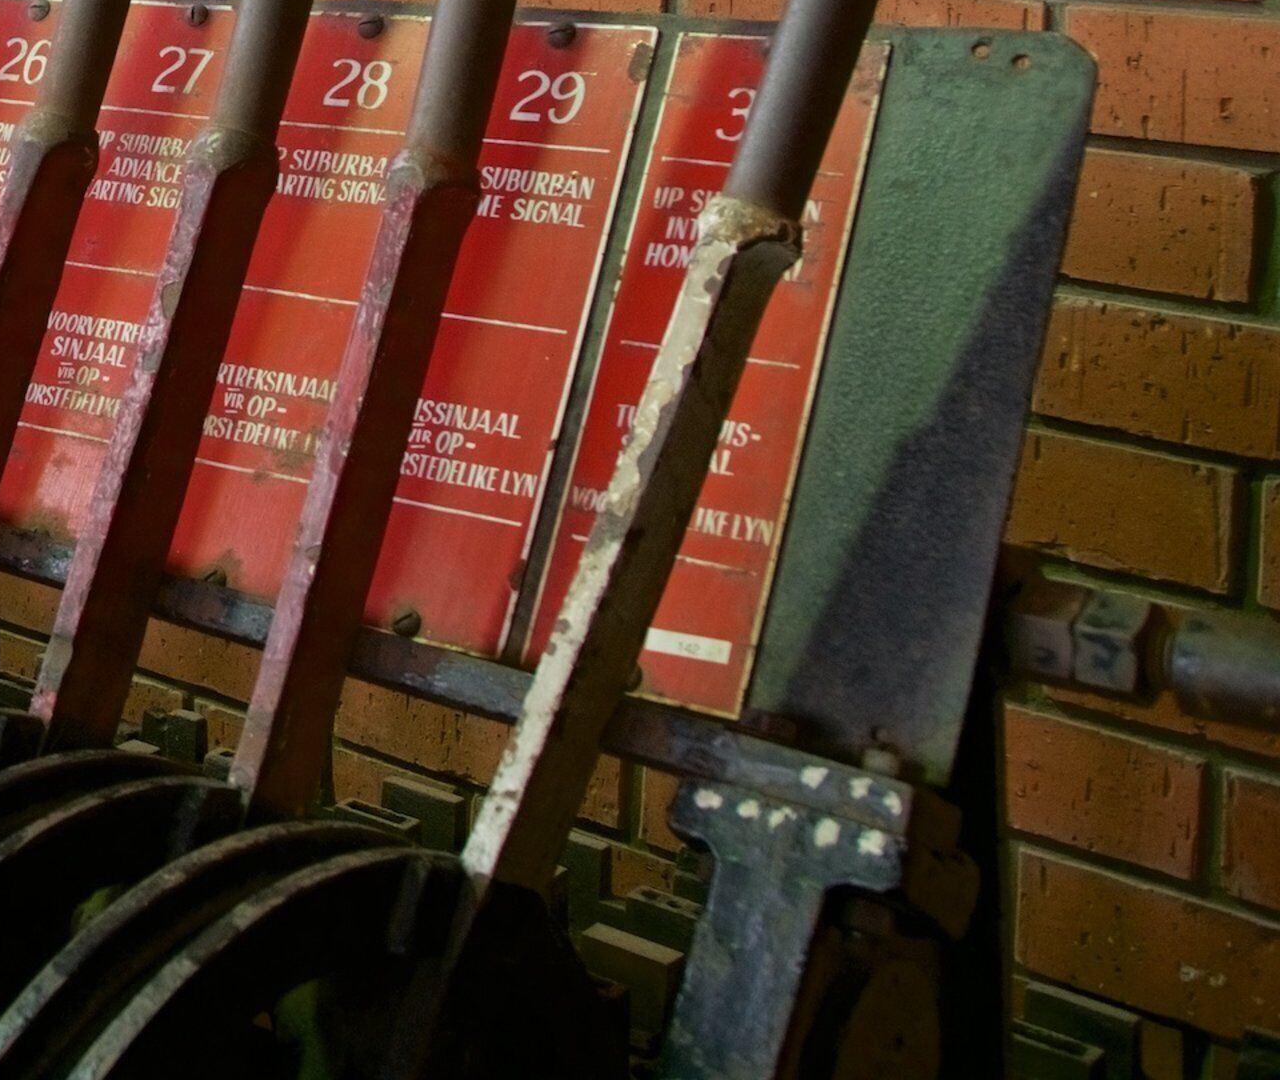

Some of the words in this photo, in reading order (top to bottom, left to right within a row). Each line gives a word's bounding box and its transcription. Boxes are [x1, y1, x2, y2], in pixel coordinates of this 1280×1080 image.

[151, 46, 215, 94] 27
[323, 58, 393, 110] 28
[509, 70, 586, 124] 29
[116, 132, 192, 159] SUBURB
[107, 156, 183, 184] ADVANCE
[289, 148, 389, 180] SUBURBA
[86, 179, 146, 205] ARTING
[276, 173, 335, 200] ARTING
[480, 166, 595, 200] SUBURBAN
[653, 186, 685, 210] UP
[510, 198, 585, 228] SIGNAL
[644, 242, 692, 269] HOM
[51, 336, 127, 368] SINJAAL
[414, 397, 522, 439] ISSINJAAL
[500, 469, 537, 498] LYN
[731, 514, 774, 546] LYN
